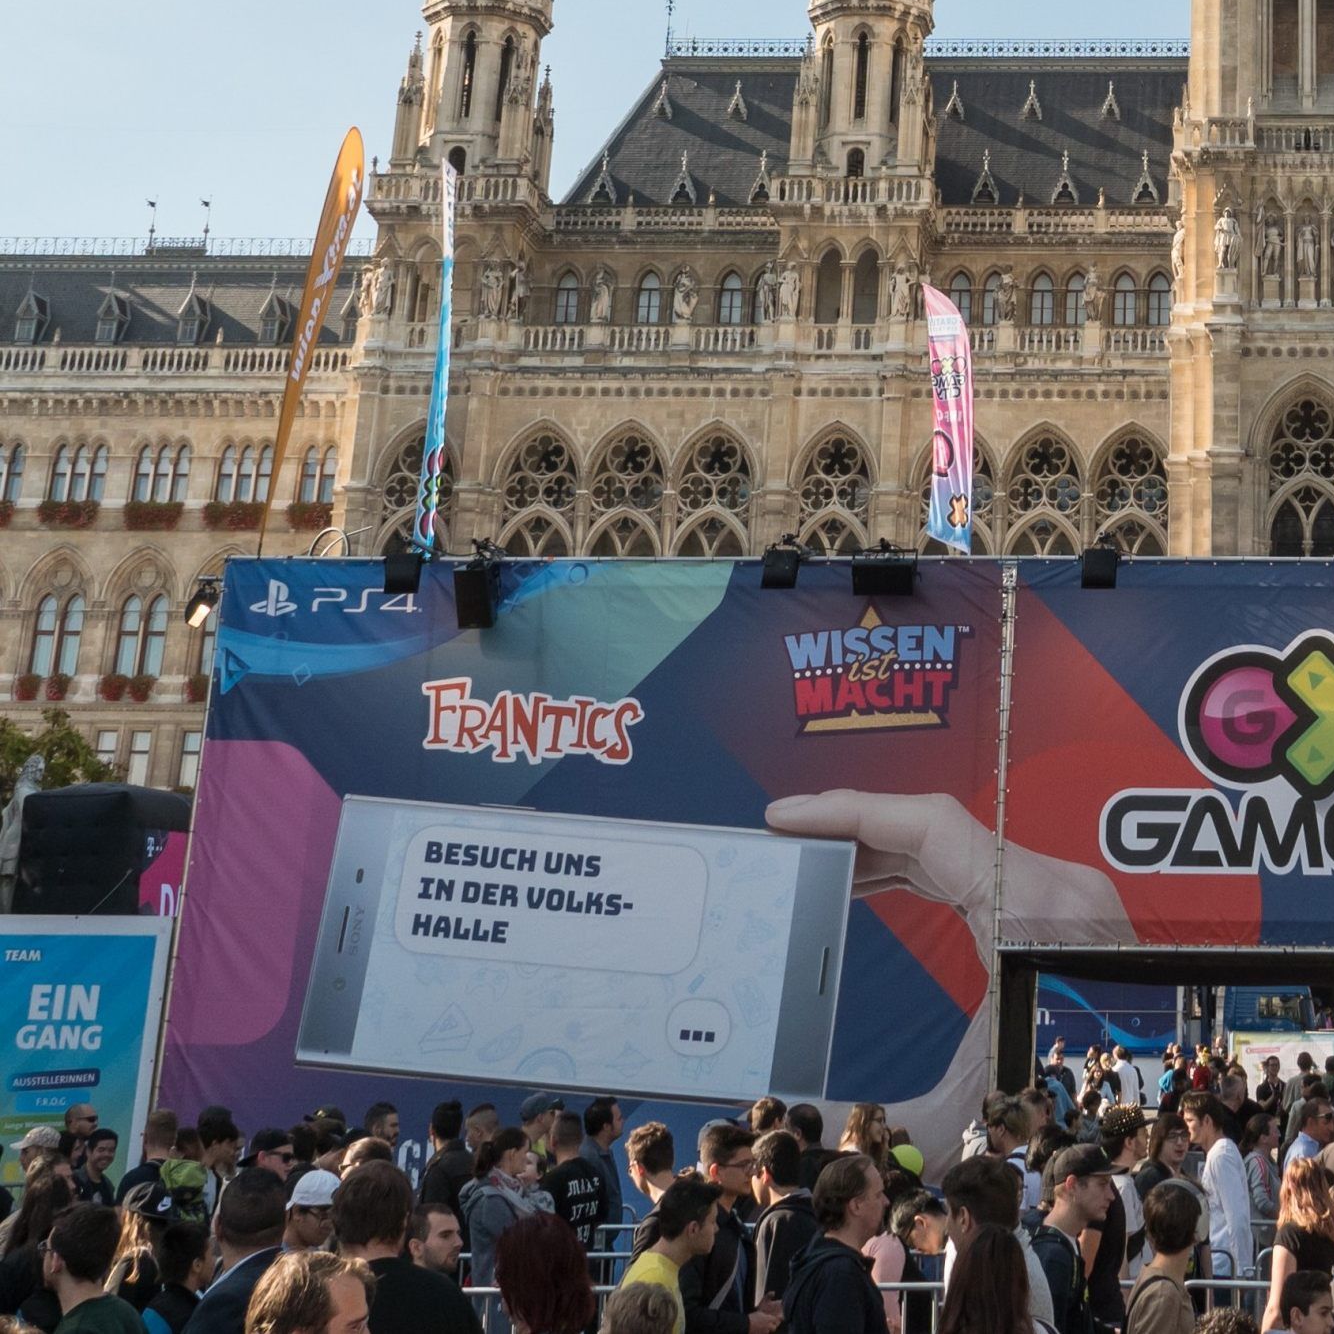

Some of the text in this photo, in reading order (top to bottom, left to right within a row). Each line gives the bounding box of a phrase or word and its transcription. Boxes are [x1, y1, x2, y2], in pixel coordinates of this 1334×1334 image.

[311, 587, 417, 613] PS4
[784, 625, 955, 670] WISSEN
[848, 650, 899, 682] ist
[795, 671, 953, 715] MACHT
[423, 679, 643, 763] FRANTICS
[424, 841, 601, 878] BESUCH UNS
[417, 877, 634, 916] IN DER VOLKS-
[349, 905, 365, 956] SONY
[411, 913, 509, 944] HALLE
[5, 949, 42, 962] TEAM
[27, 984, 101, 1021] EIN
[15, 1024, 103, 1051] GANG
[12, 1073, 96, 1087] AUSSTELLERINNEN
